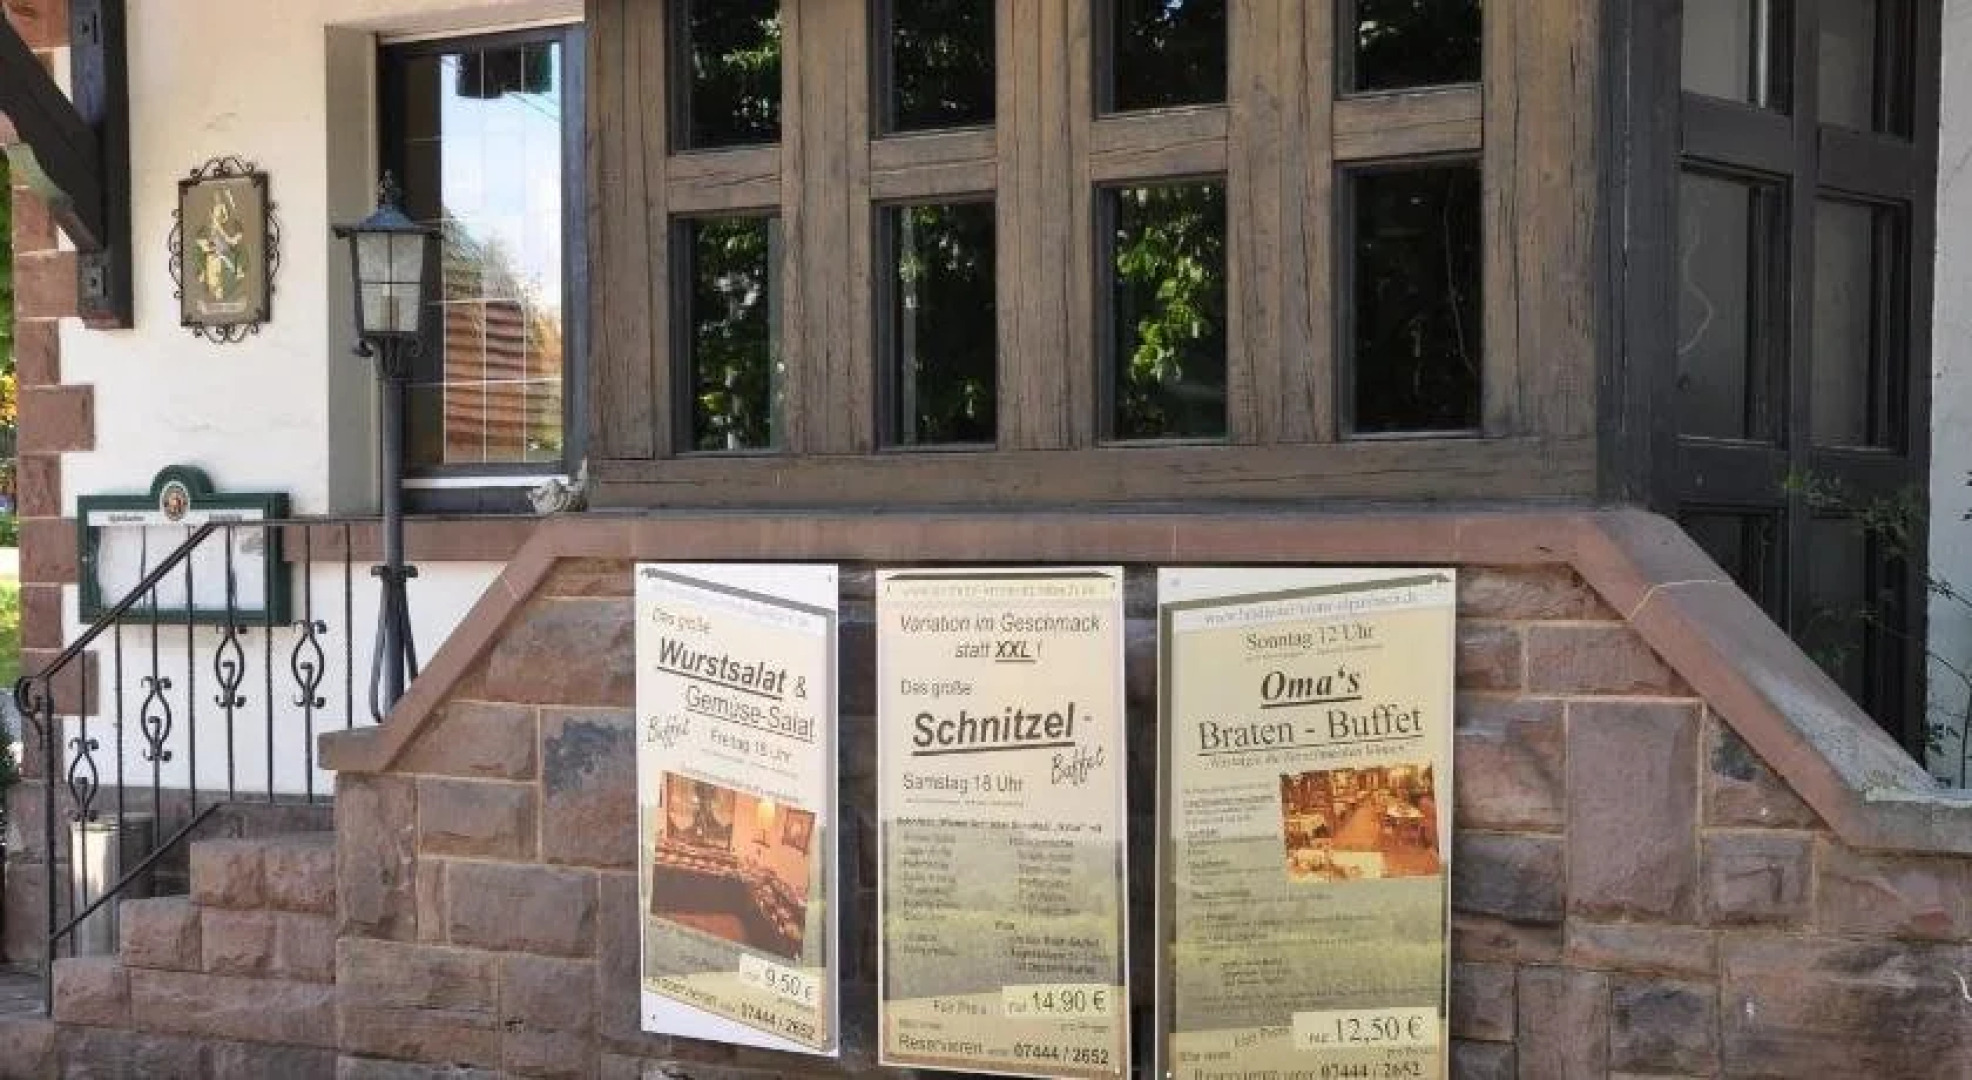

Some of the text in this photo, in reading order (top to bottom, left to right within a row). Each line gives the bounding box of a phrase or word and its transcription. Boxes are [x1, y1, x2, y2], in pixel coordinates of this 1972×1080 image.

[900, 613, 1101, 633] Variation im Geschmack
[1246, 621, 1373, 650] Sonntag 12 Uhr
[955, 641, 989, 658] statt
[659, 636, 807, 700] Wurstsalat &
[901, 678, 972, 698] Das große
[686, 685, 816, 740] Gemüse-Salat
[1199, 720, 1294, 750] Braten
[1327, 704, 1423, 739] Buffet
[903, 773, 1023, 793] Samstag 18 Uhr
[1093, 990, 1107, 1012] €
[1335, 1015, 1400, 1044] 12,50
[1407, 1015, 1425, 1041] €
[899, 1033, 983, 1055] Reservieren
[1013, 1042, 1059, 1061] 07444
[1072, 1047, 1109, 1064] 2652
[1321, 1063, 1367, 1080] 07444
[1383, 1061, 1421, 1078] 2652
